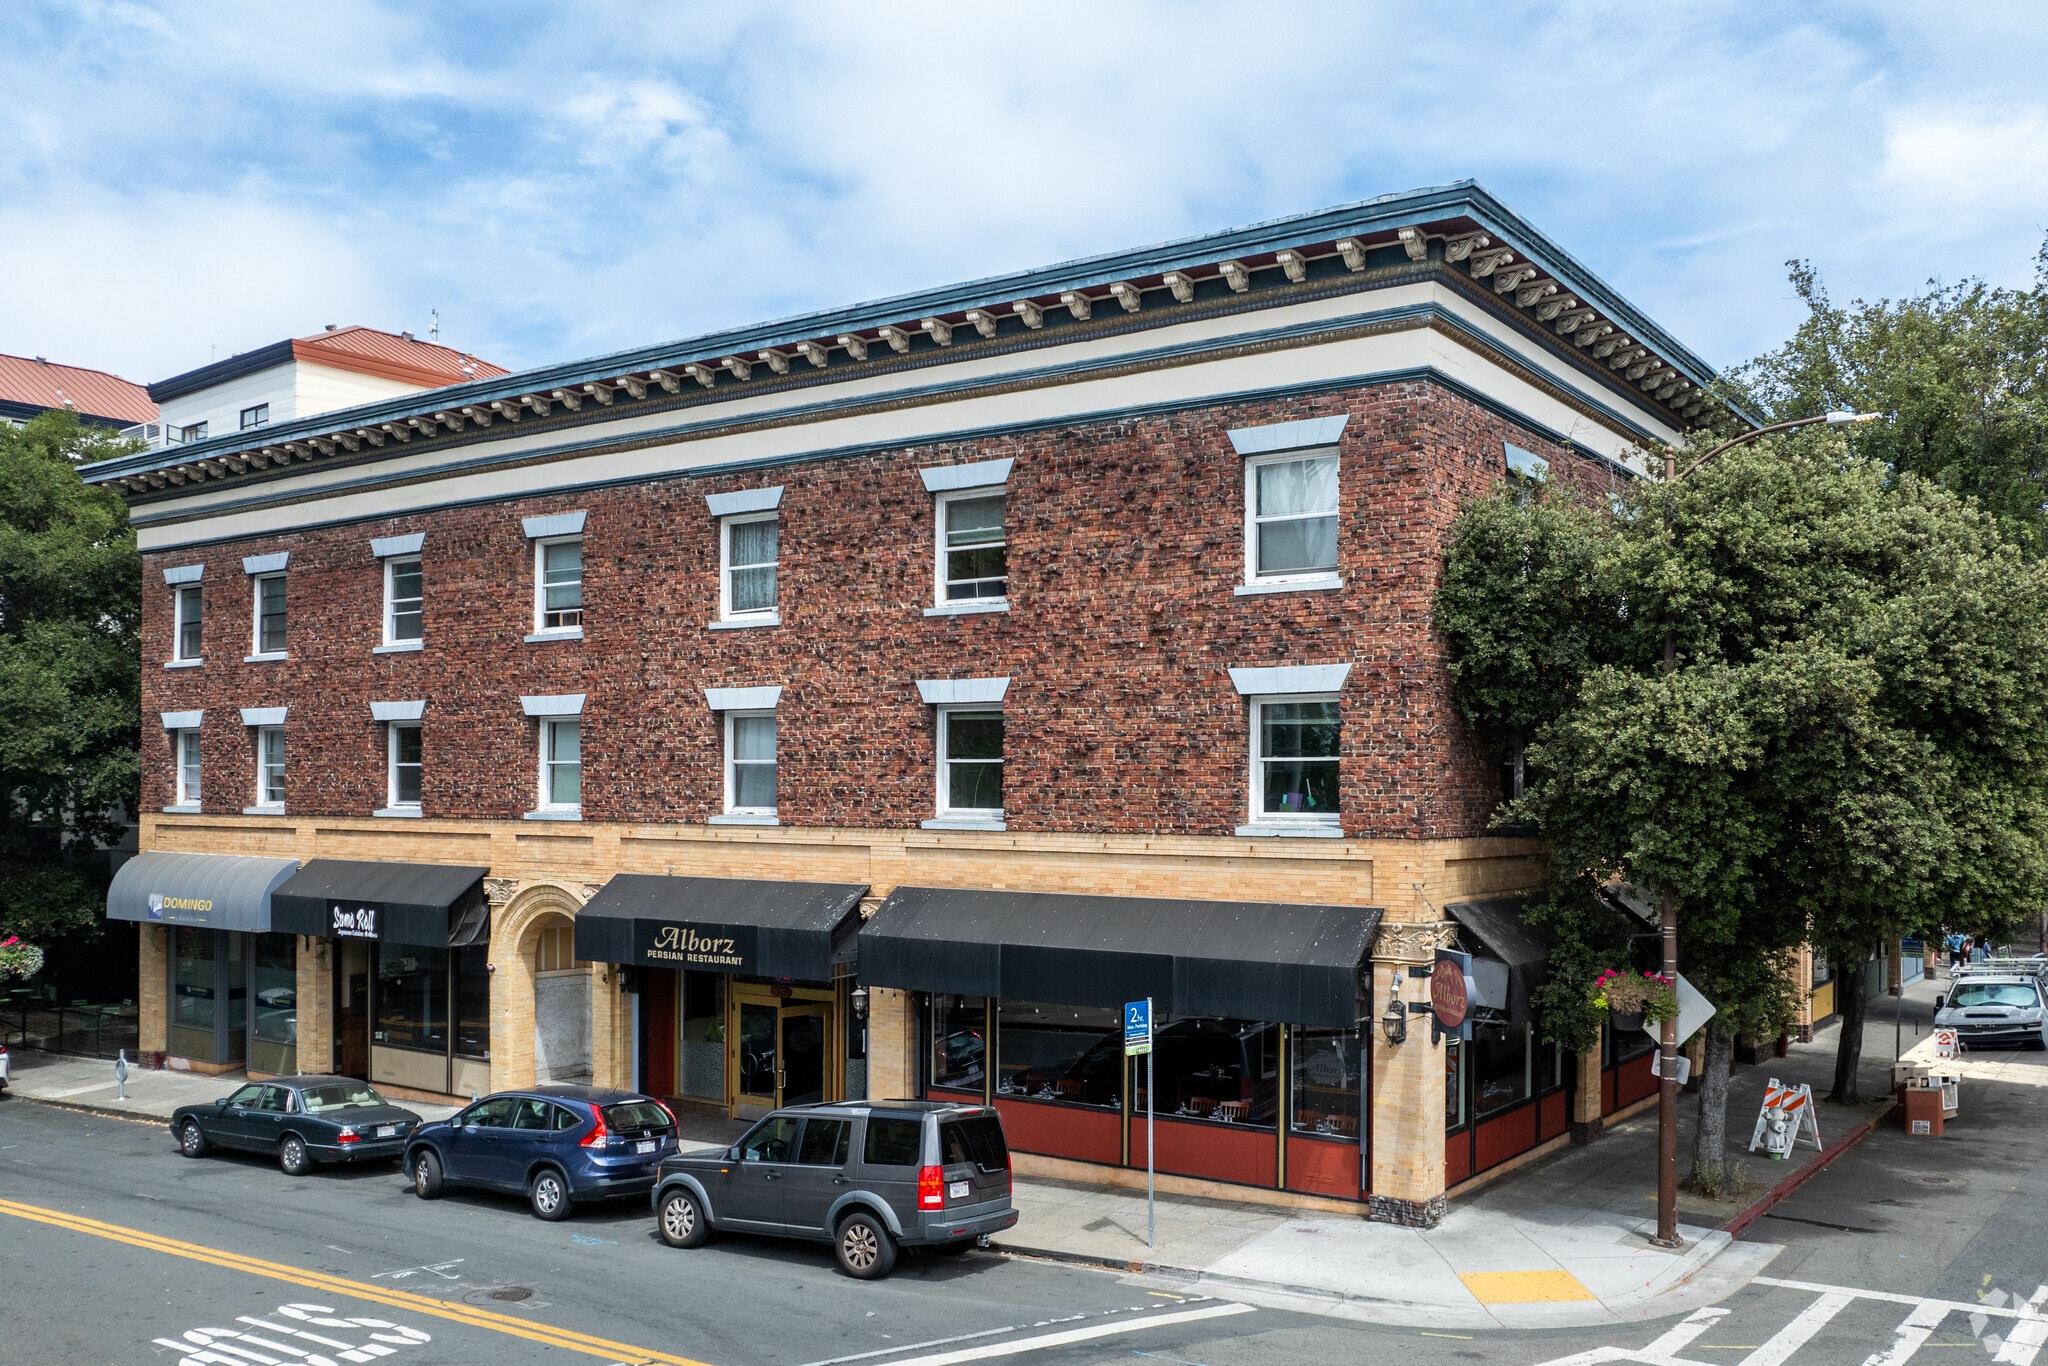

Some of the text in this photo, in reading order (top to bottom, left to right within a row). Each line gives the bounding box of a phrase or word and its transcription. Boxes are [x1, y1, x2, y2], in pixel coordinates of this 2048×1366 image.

[163, 897, 212, 911] DOMINGO
[356, 909, 374, 932] Roll
[654, 926, 735, 954] Alborz
[647, 949, 743, 966] PERSIAN RESTAURANT
[1432, 982, 1465, 1009] Alborz
[1130, 1007, 1138, 1023] 2
[1308, 1063, 1343, 1075] Albor
